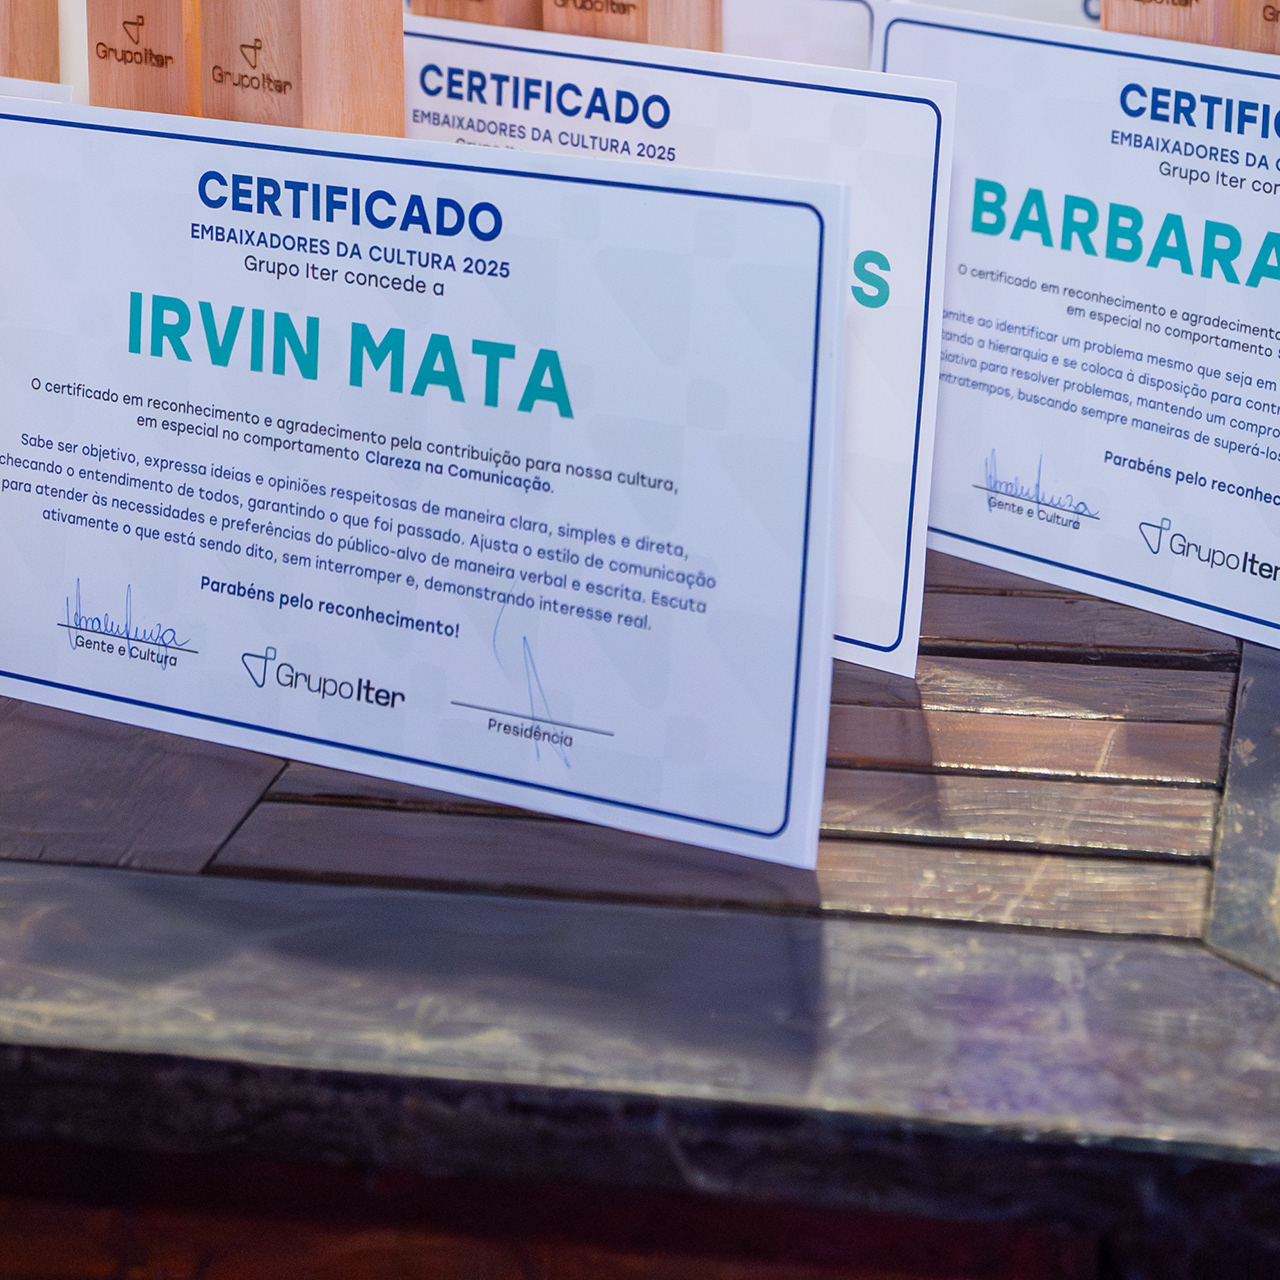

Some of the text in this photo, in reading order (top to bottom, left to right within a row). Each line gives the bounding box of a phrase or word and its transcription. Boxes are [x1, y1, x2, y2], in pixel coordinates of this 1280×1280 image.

[419, 63, 671, 130] CERTIFICADO
[412, 108, 526, 140] EMBAIXADORES
[530, 126, 553, 144] DA
[558, 131, 631, 156] CULTURA
[636, 142, 677, 162] 2025
[1110, 129, 1240, 165] EMBAIXADORES
[1245, 151, 1269, 171] DA
[1158, 161, 1211, 185] Grupo
[1215, 170, 1247, 189] Iter
[198, 170, 503, 242] CERTIFICADO
[191, 222, 510, 279] EMBAIXADORES DA CULTURA 2025
[244, 254, 445, 296] Grupo Iter concede a
[128, 291, 574, 419] IRVIN MATA
[31, 377, 422, 451] O certificado em reconhecimento agradecimento pela
[21, 433, 252, 484] Sabe ser objetivo, expressa ideias
[136, 415, 421, 471] em especial comportamento Clareza
[78, 468, 173, 494] entendimento
[198, 487, 243, 509] todos,
[1104, 450, 1172, 479] Parabéns
[1175, 470, 1207, 488] pelo
[1, 478, 205, 524] para atender às necessidades
[42, 508, 242, 555] ativamente o que está sendo
[200, 575, 460, 638] Parabéns pelo reconhecimento!
[72, 634, 178, 668] Gente e Cultura
[487, 717, 573, 747] Presidência
